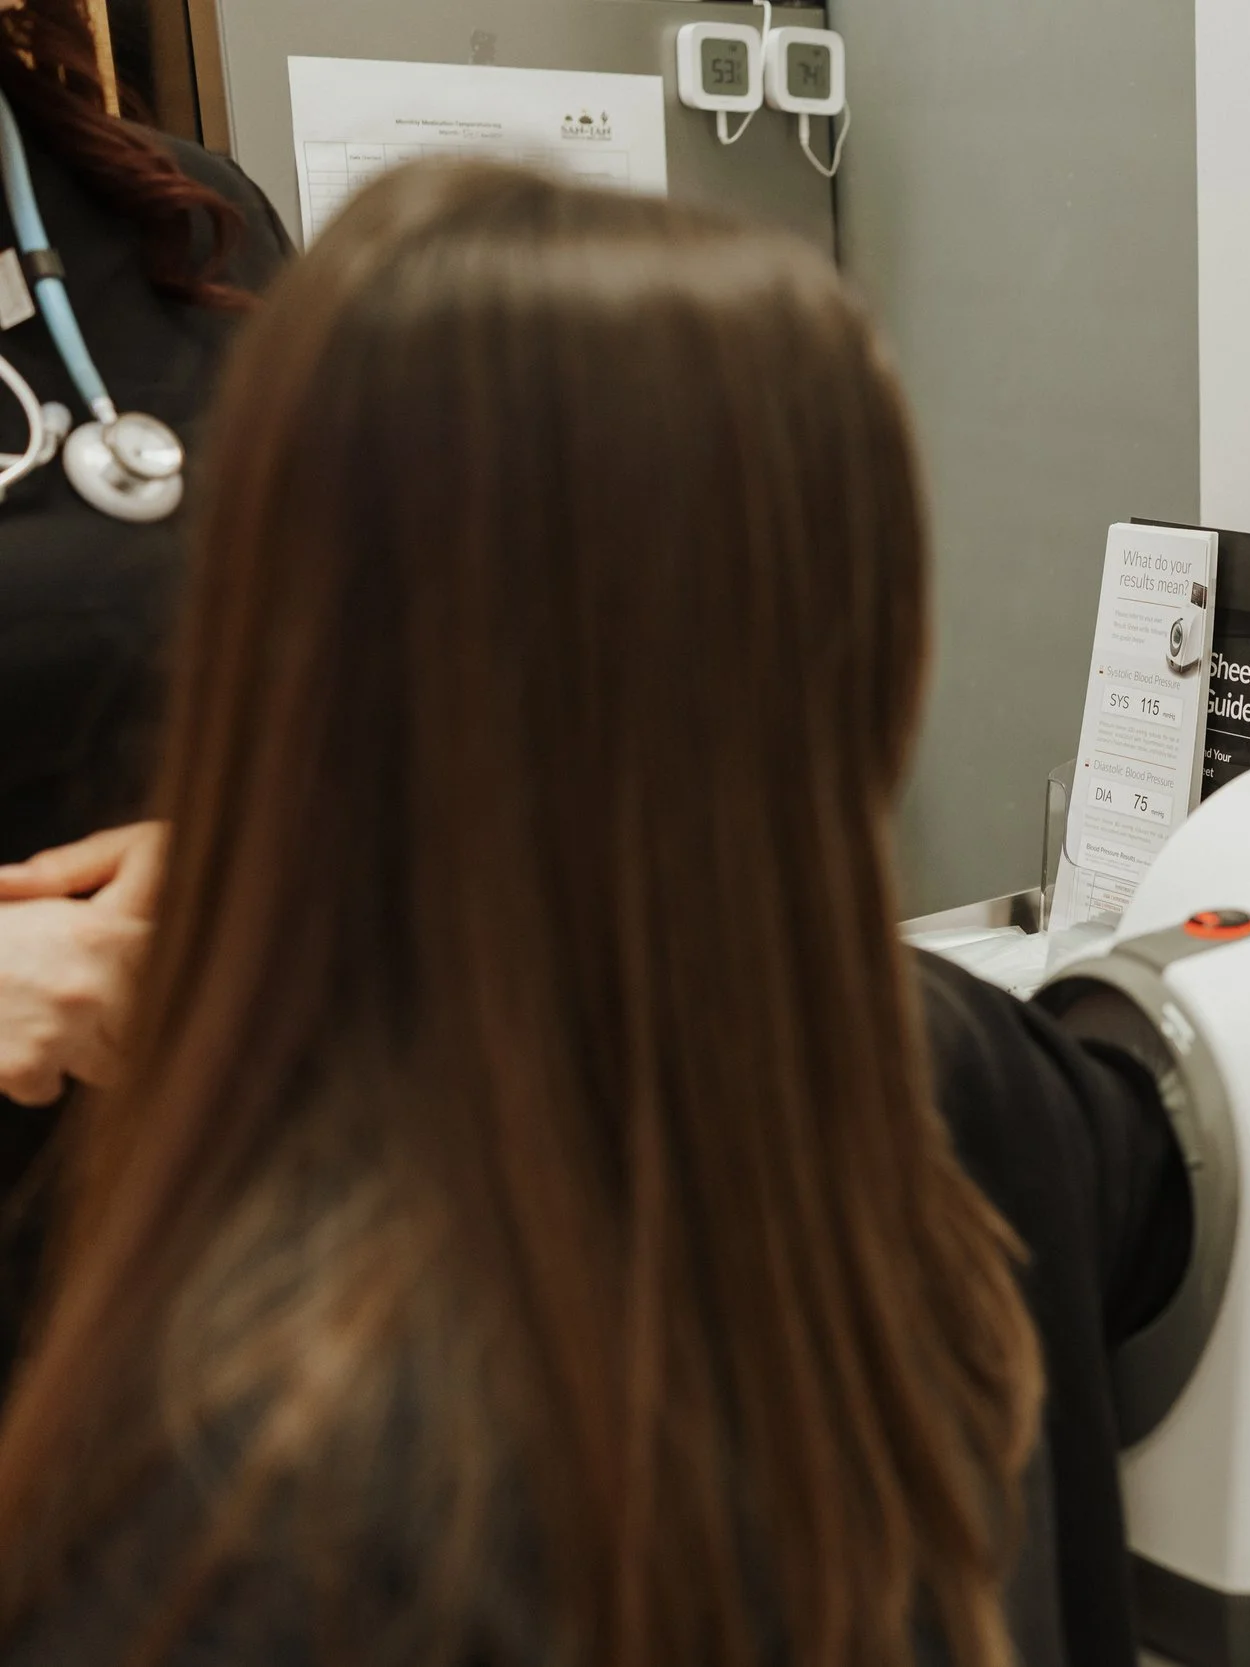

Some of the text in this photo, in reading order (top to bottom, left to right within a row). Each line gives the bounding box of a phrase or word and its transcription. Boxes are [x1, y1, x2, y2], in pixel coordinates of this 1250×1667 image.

[712, 58, 735, 84] 53
[1123, 549, 1192, 575] What do your
[1120, 573, 1189, 596] results mean?
[1107, 665, 1180, 690] Systolic Blood Pressure
[1110, 693, 1130, 709] SYS
[1141, 697, 1160, 716] 115
[1213, 749, 1232, 763] Your
[1093, 759, 1175, 788] Diastolic Blood Pressure
[1095, 787, 1112, 803] DIA
[1134, 793, 1148, 812] 75
[1086, 842, 1100, 852] Blood
[1100, 846, 1120, 858] Pressure
